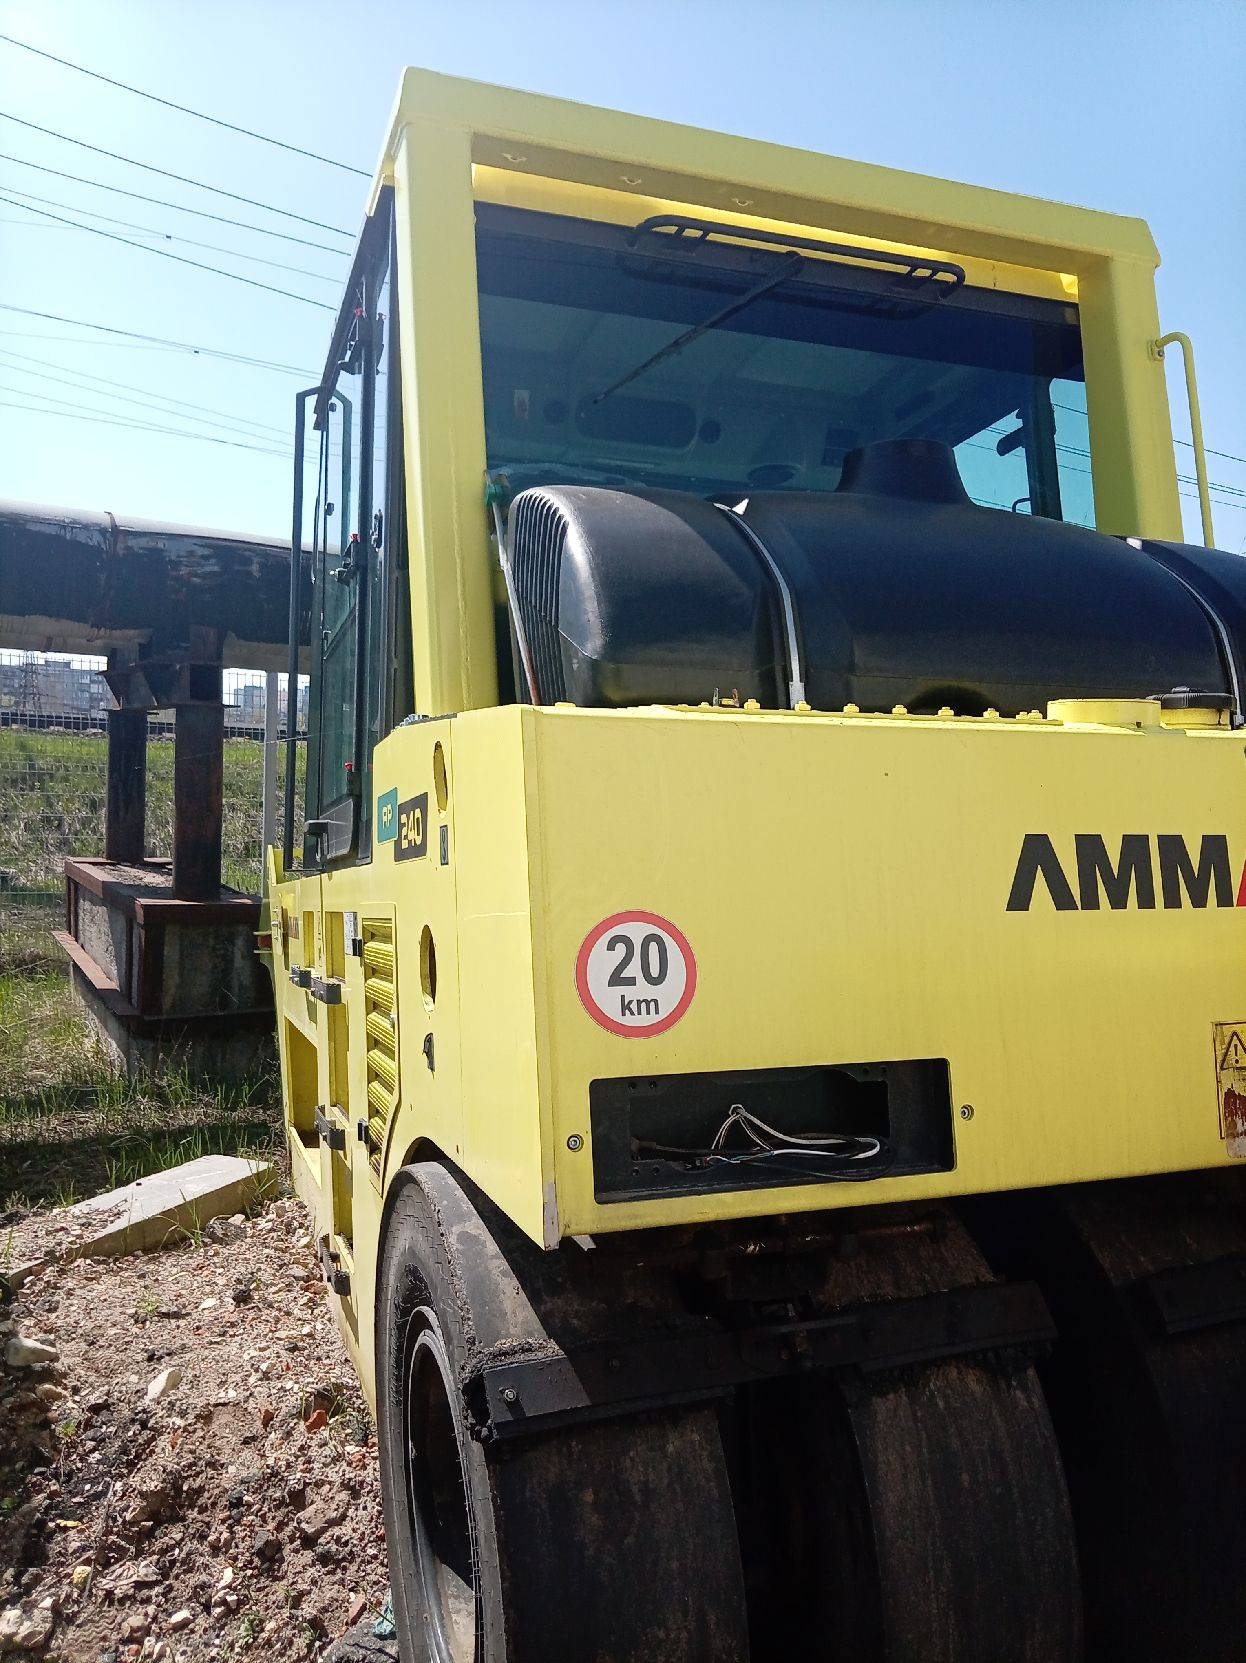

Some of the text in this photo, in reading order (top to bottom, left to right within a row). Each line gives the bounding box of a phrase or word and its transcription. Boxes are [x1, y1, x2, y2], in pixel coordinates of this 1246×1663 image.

[401, 808, 423, 850] 240
[1006, 834, 1246, 911] AMM
[606, 933, 669, 987] 20
[620, 994, 660, 1017] km
